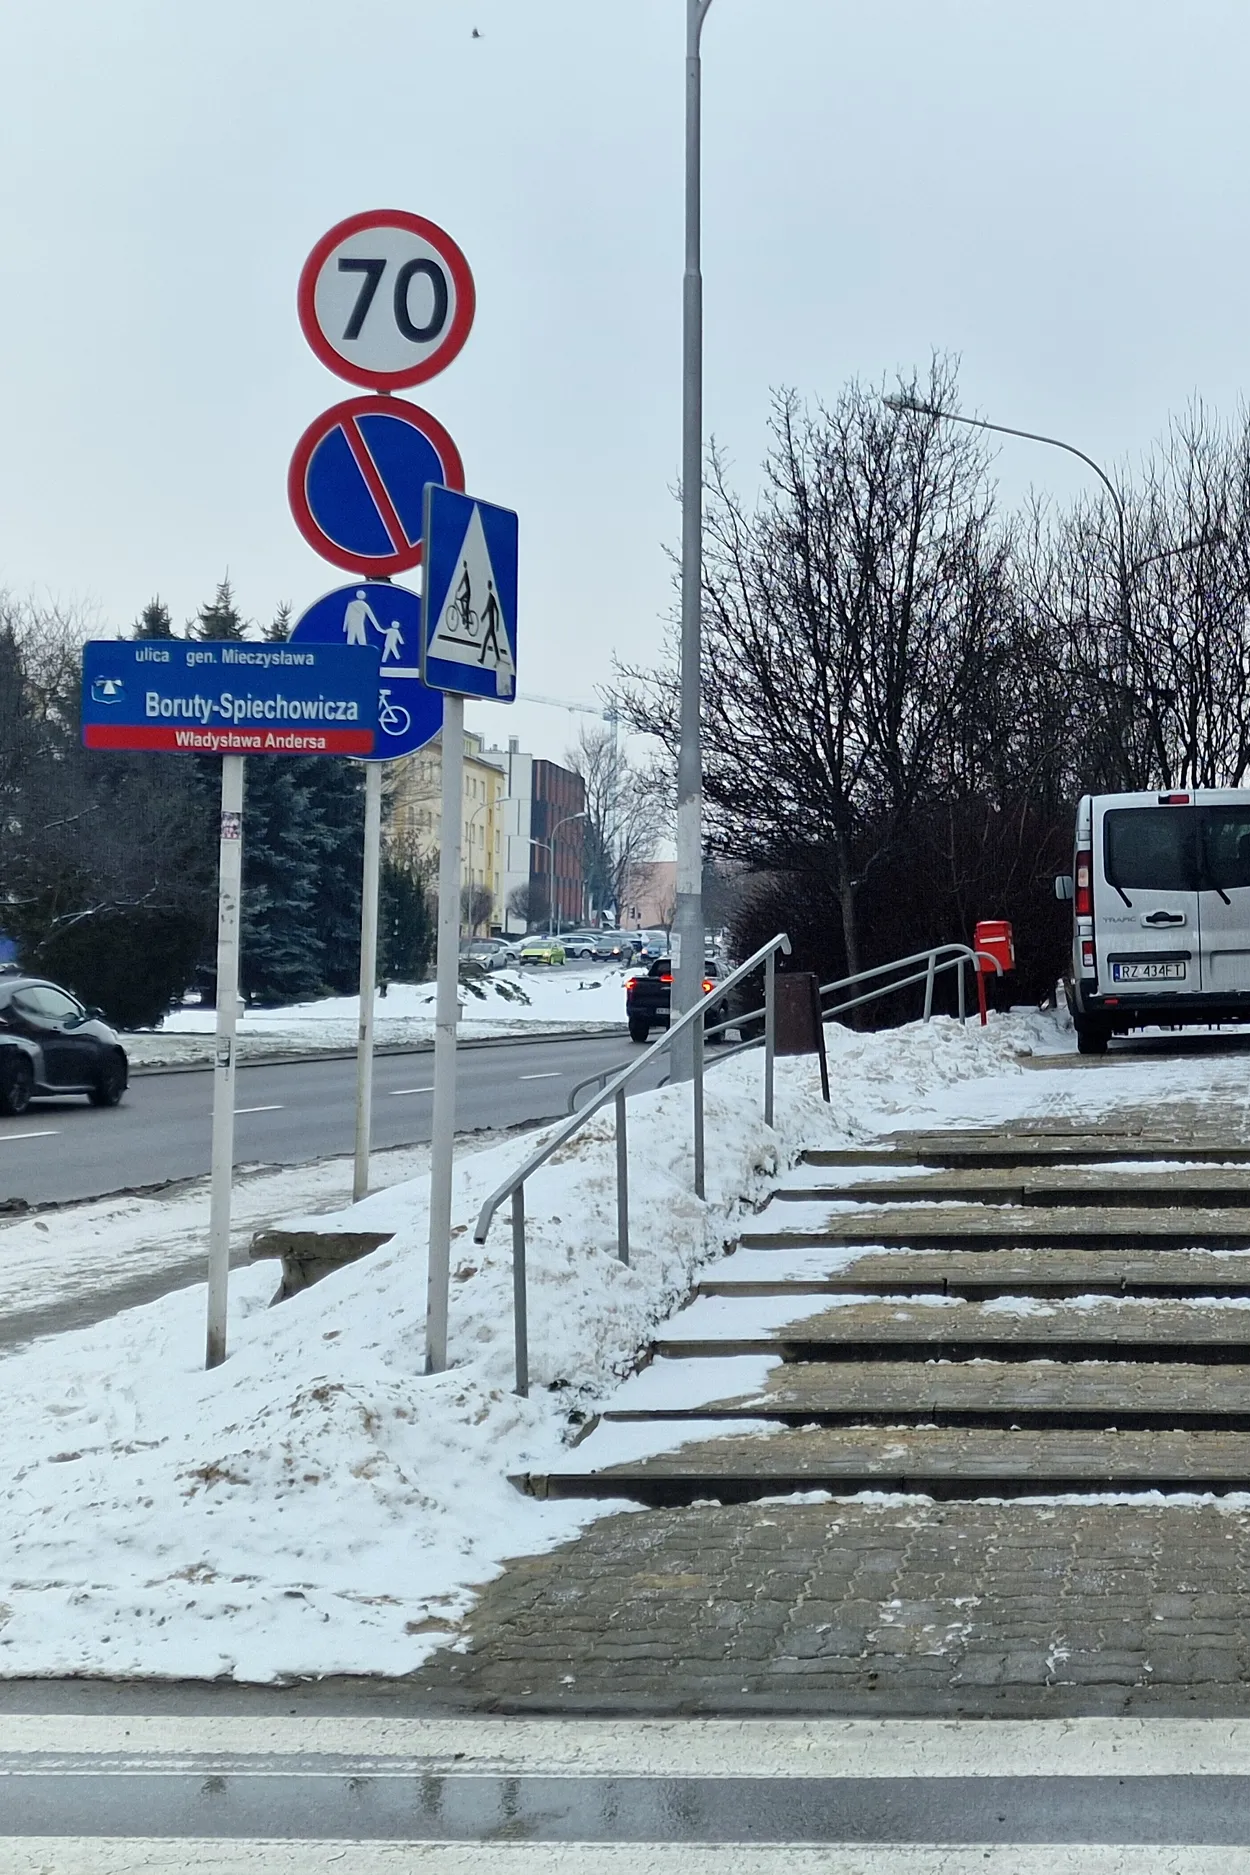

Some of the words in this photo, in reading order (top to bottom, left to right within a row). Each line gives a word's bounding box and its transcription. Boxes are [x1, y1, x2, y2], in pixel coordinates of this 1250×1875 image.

[337, 258, 449, 344] 70
[135, 647, 170, 663] ulica
[186, 650, 217, 667] gen.
[222, 648, 314, 669] Mieczysława
[145, 691, 359, 724] Boruty-Spiechowicza
[175, 730, 261, 751] Władysława
[264, 733, 326, 750] Andersa
[1122, 965, 1139, 978] RZ
[1143, 964, 1181, 977] 434FT
